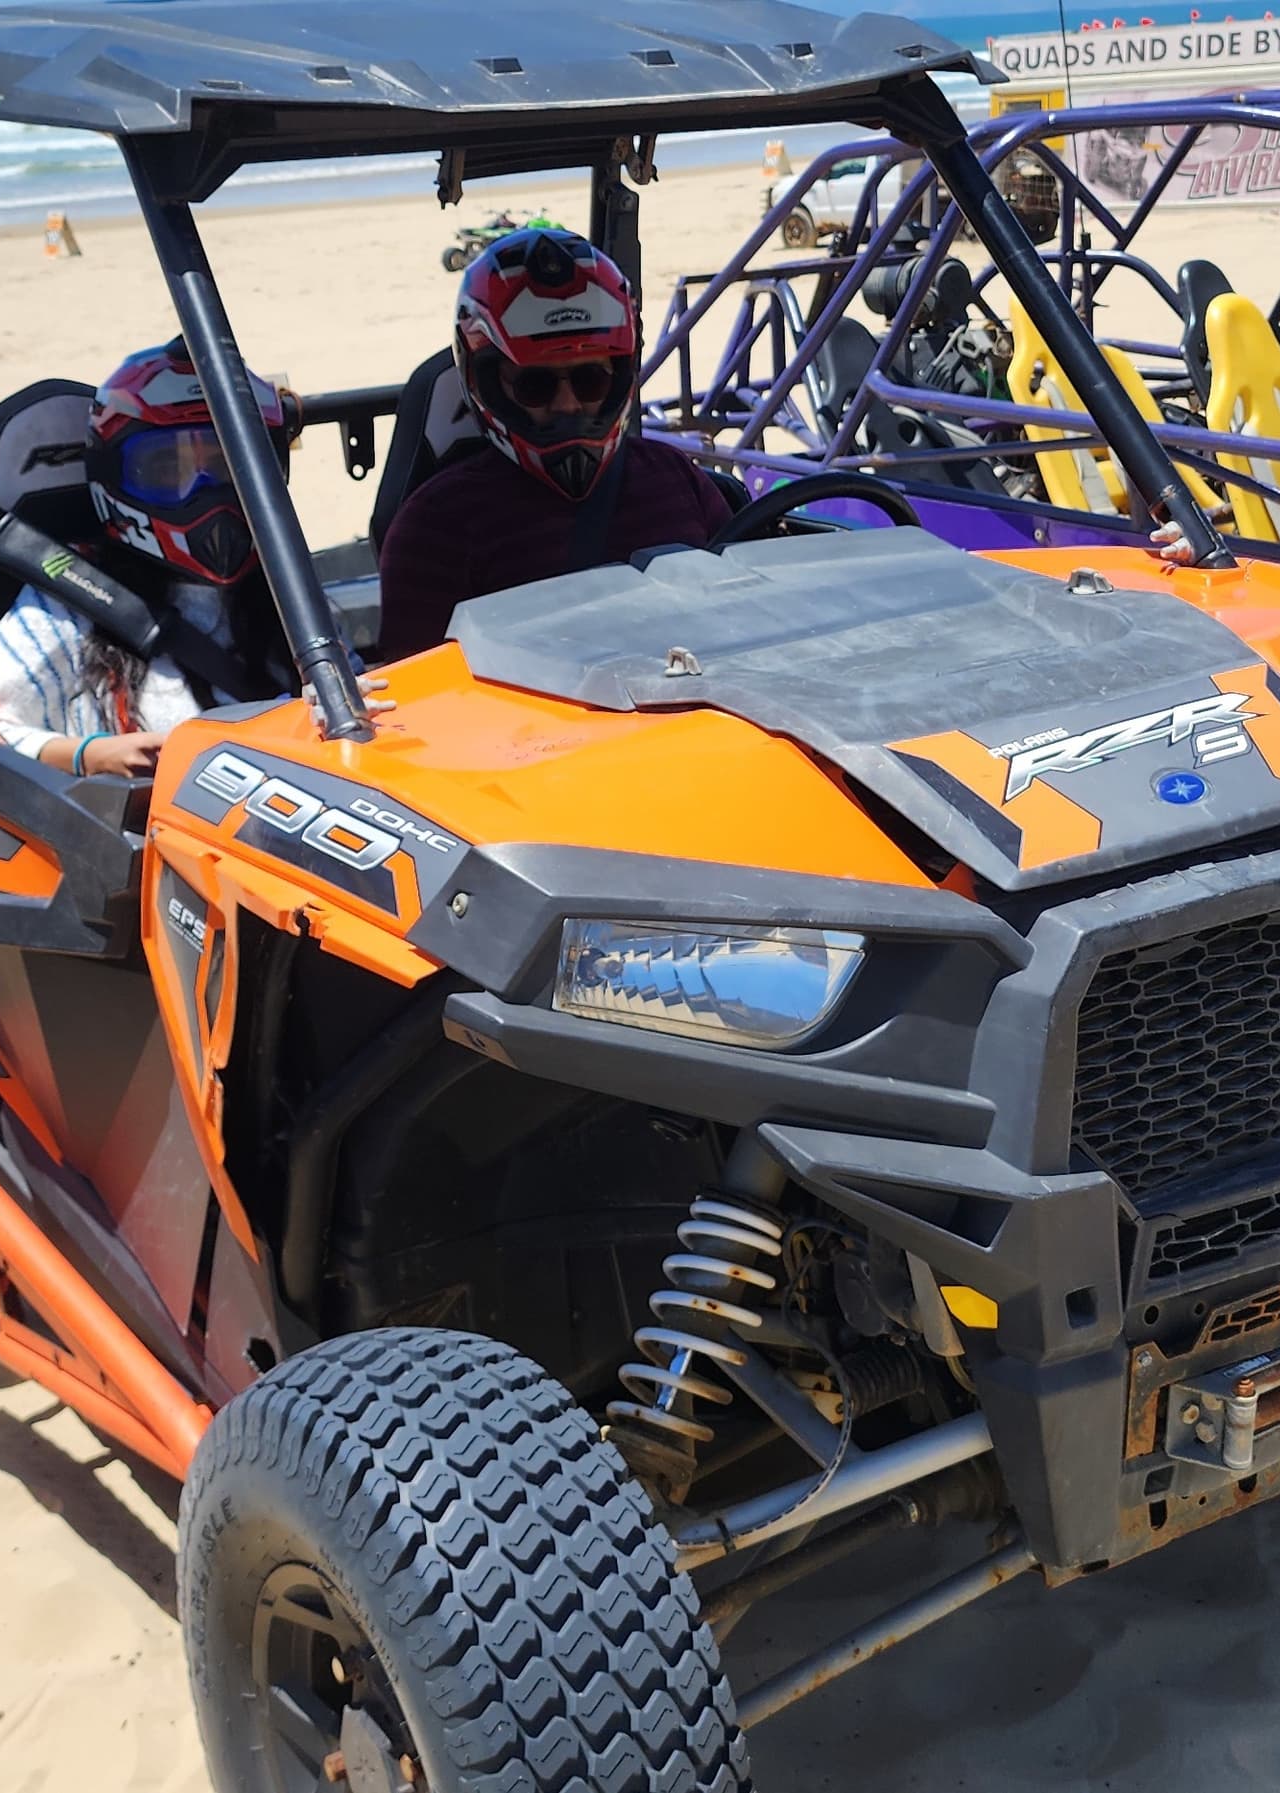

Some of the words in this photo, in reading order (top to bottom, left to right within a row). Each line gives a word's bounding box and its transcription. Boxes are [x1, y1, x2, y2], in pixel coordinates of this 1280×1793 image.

[1004, 41, 1095, 71] QUADS
[1106, 38, 1168, 64] AND
[1179, 33, 1241, 58] SIDE
[1190, 153, 1250, 198] ATV
[988, 727, 1070, 759] POLARIS
[1001, 692, 1268, 806] RZR
[1192, 725, 1254, 769] S
[194, 751, 404, 871] 900
[348, 797, 462, 854] DOHC
[168, 897, 206, 940] EPS
